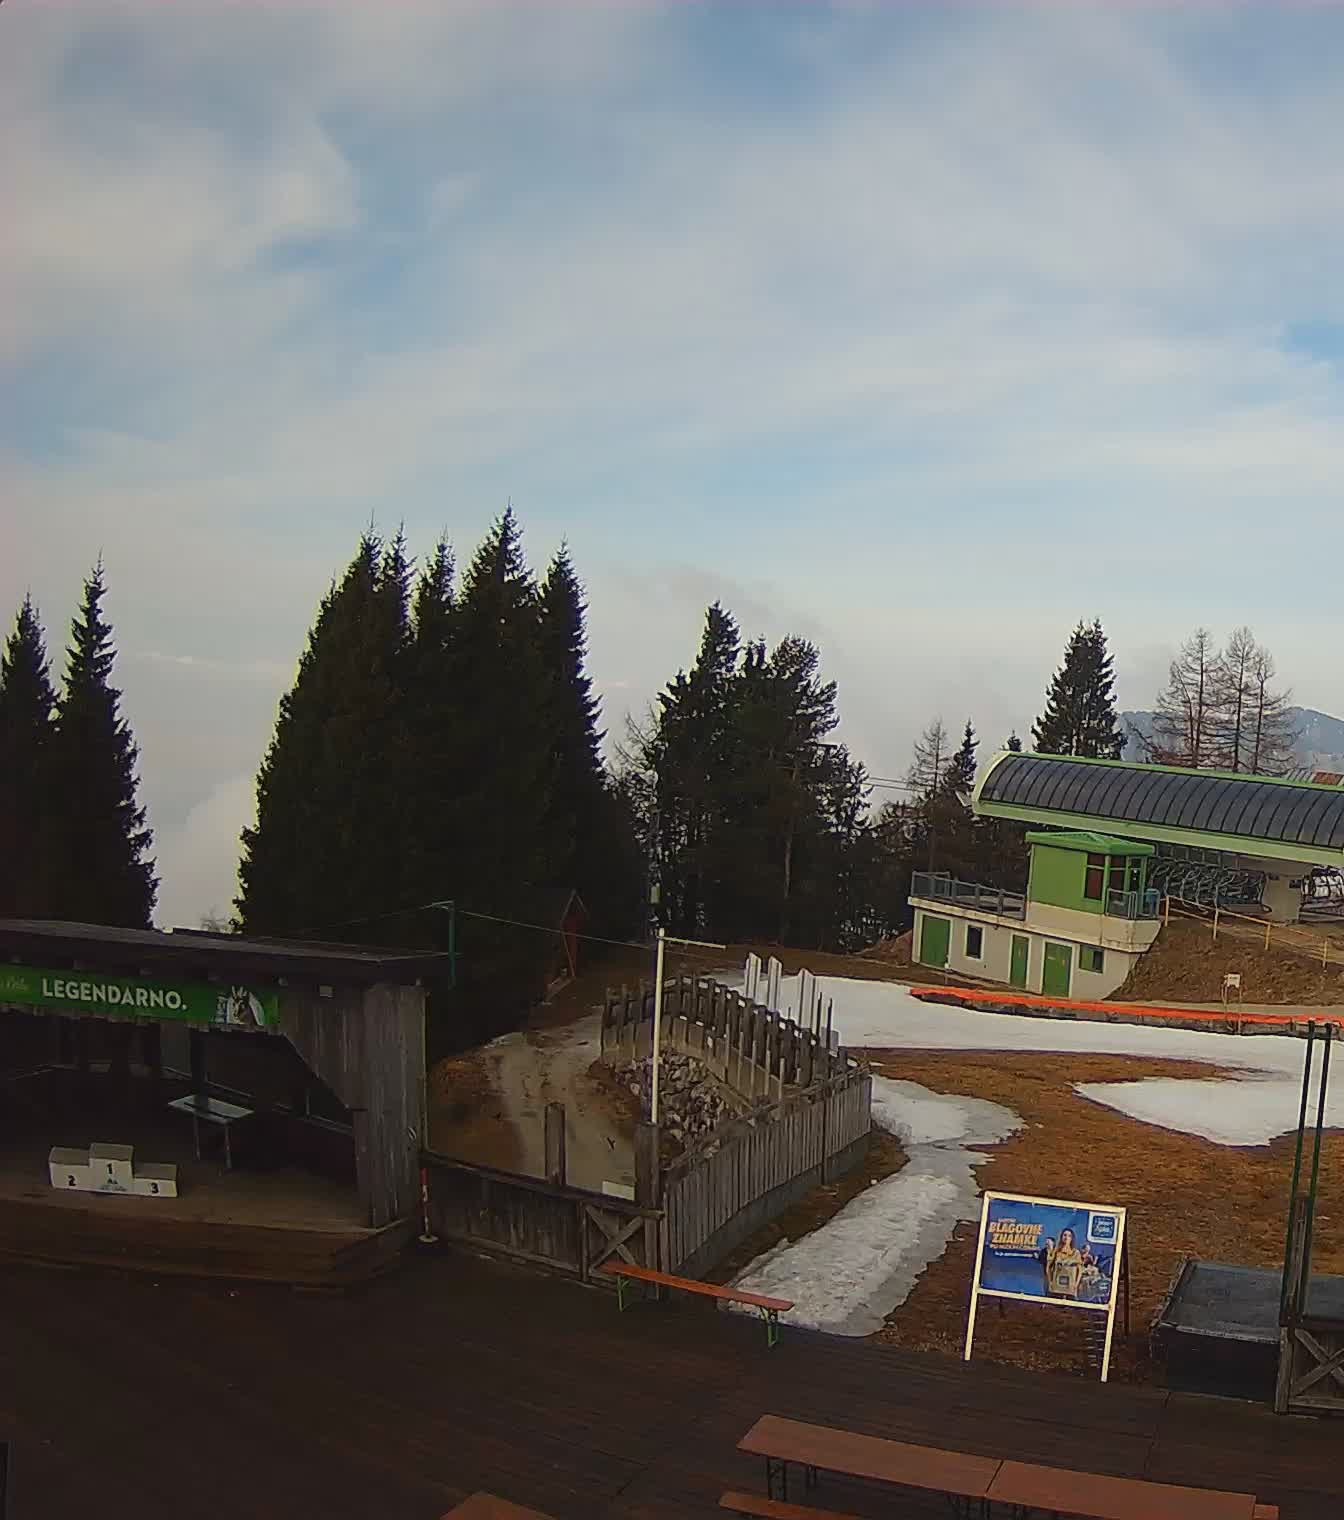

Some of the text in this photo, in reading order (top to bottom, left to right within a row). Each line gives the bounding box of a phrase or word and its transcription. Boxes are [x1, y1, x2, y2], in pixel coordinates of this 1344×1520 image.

[42, 978, 187, 1010] LEGENDARNO.
[106, 1163, 113, 1174] 1
[67, 1175, 76, 1186] 2
[151, 1182, 159, 1193] 3
